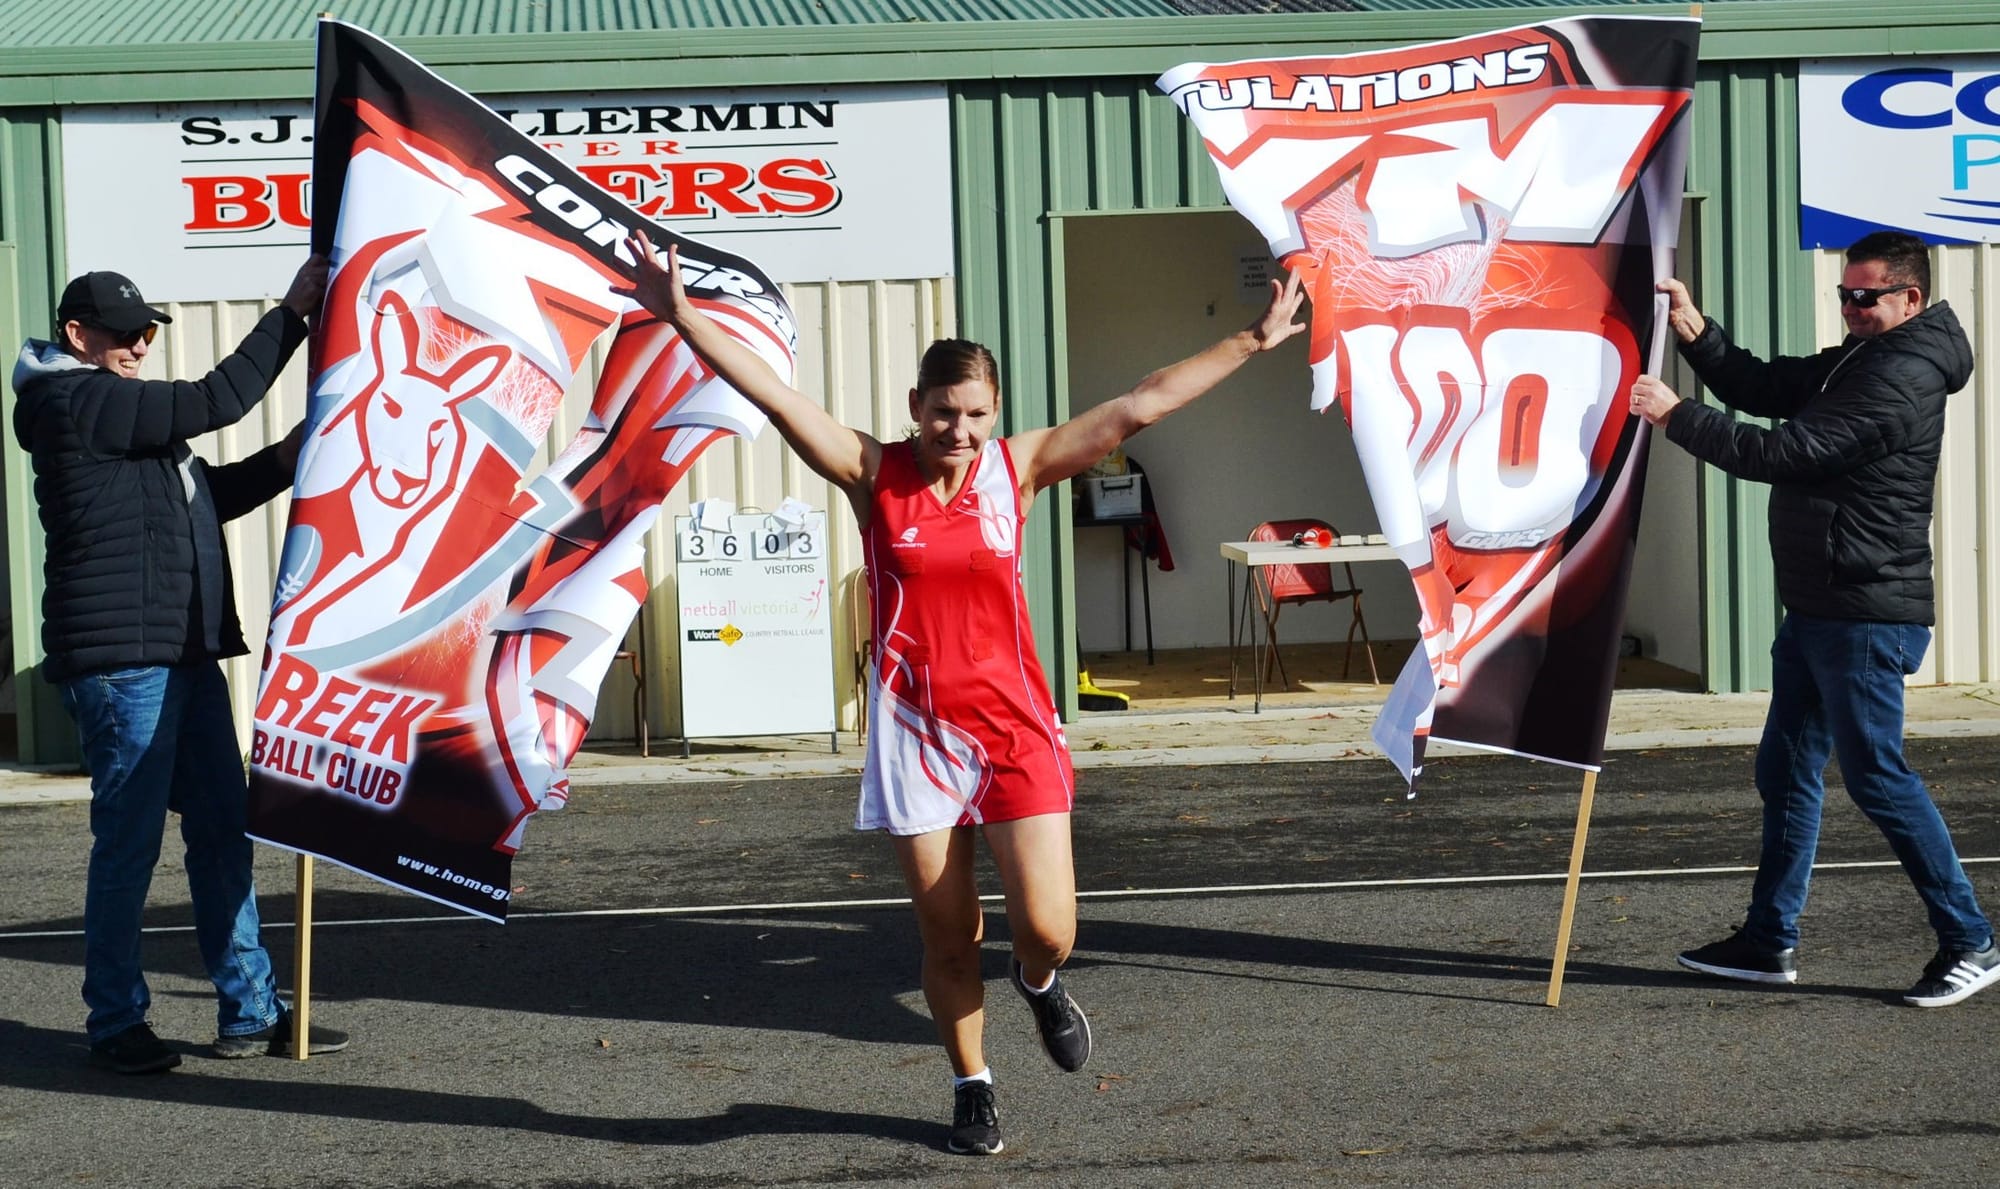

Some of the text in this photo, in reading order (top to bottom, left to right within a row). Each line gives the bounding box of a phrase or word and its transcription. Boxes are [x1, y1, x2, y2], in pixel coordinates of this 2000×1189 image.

[1168, 43, 1550, 116] TULATIONS
[699, 564, 816, 577] HOME VISITORS
[684, 600, 799, 616] netball victoria
[255, 645, 437, 764] REEK
[326, 752, 402, 806] CLUB
